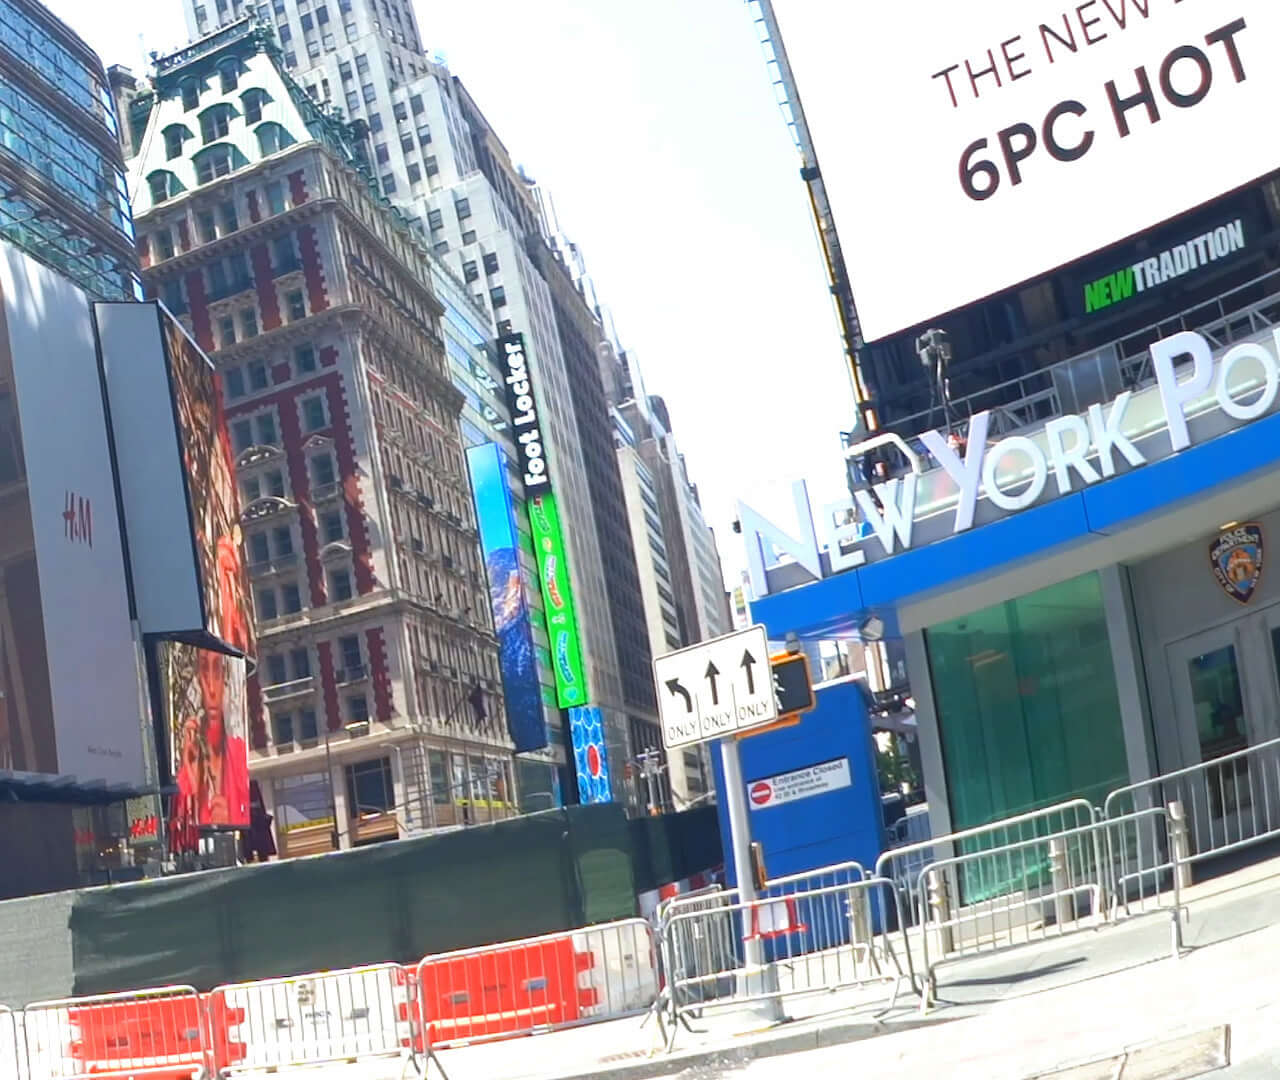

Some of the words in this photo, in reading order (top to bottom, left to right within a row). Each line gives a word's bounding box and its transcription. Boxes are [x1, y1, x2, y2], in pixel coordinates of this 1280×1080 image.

[931, 34, 1032, 108] THE
[958, 99, 1096, 201] 6PC
[1104, 17, 1247, 139] HOT
[504, 341, 536, 426] Locker
[518, 428, 547, 486] Foot
[736, 472, 917, 597] NEW
[919, 389, 1147, 533] YORK
[1151, 327, 1280, 451] PO
[668, 723, 697, 741] ONLY
[703, 711, 732, 731] ONLY
[738, 701, 769, 721] ONLY
